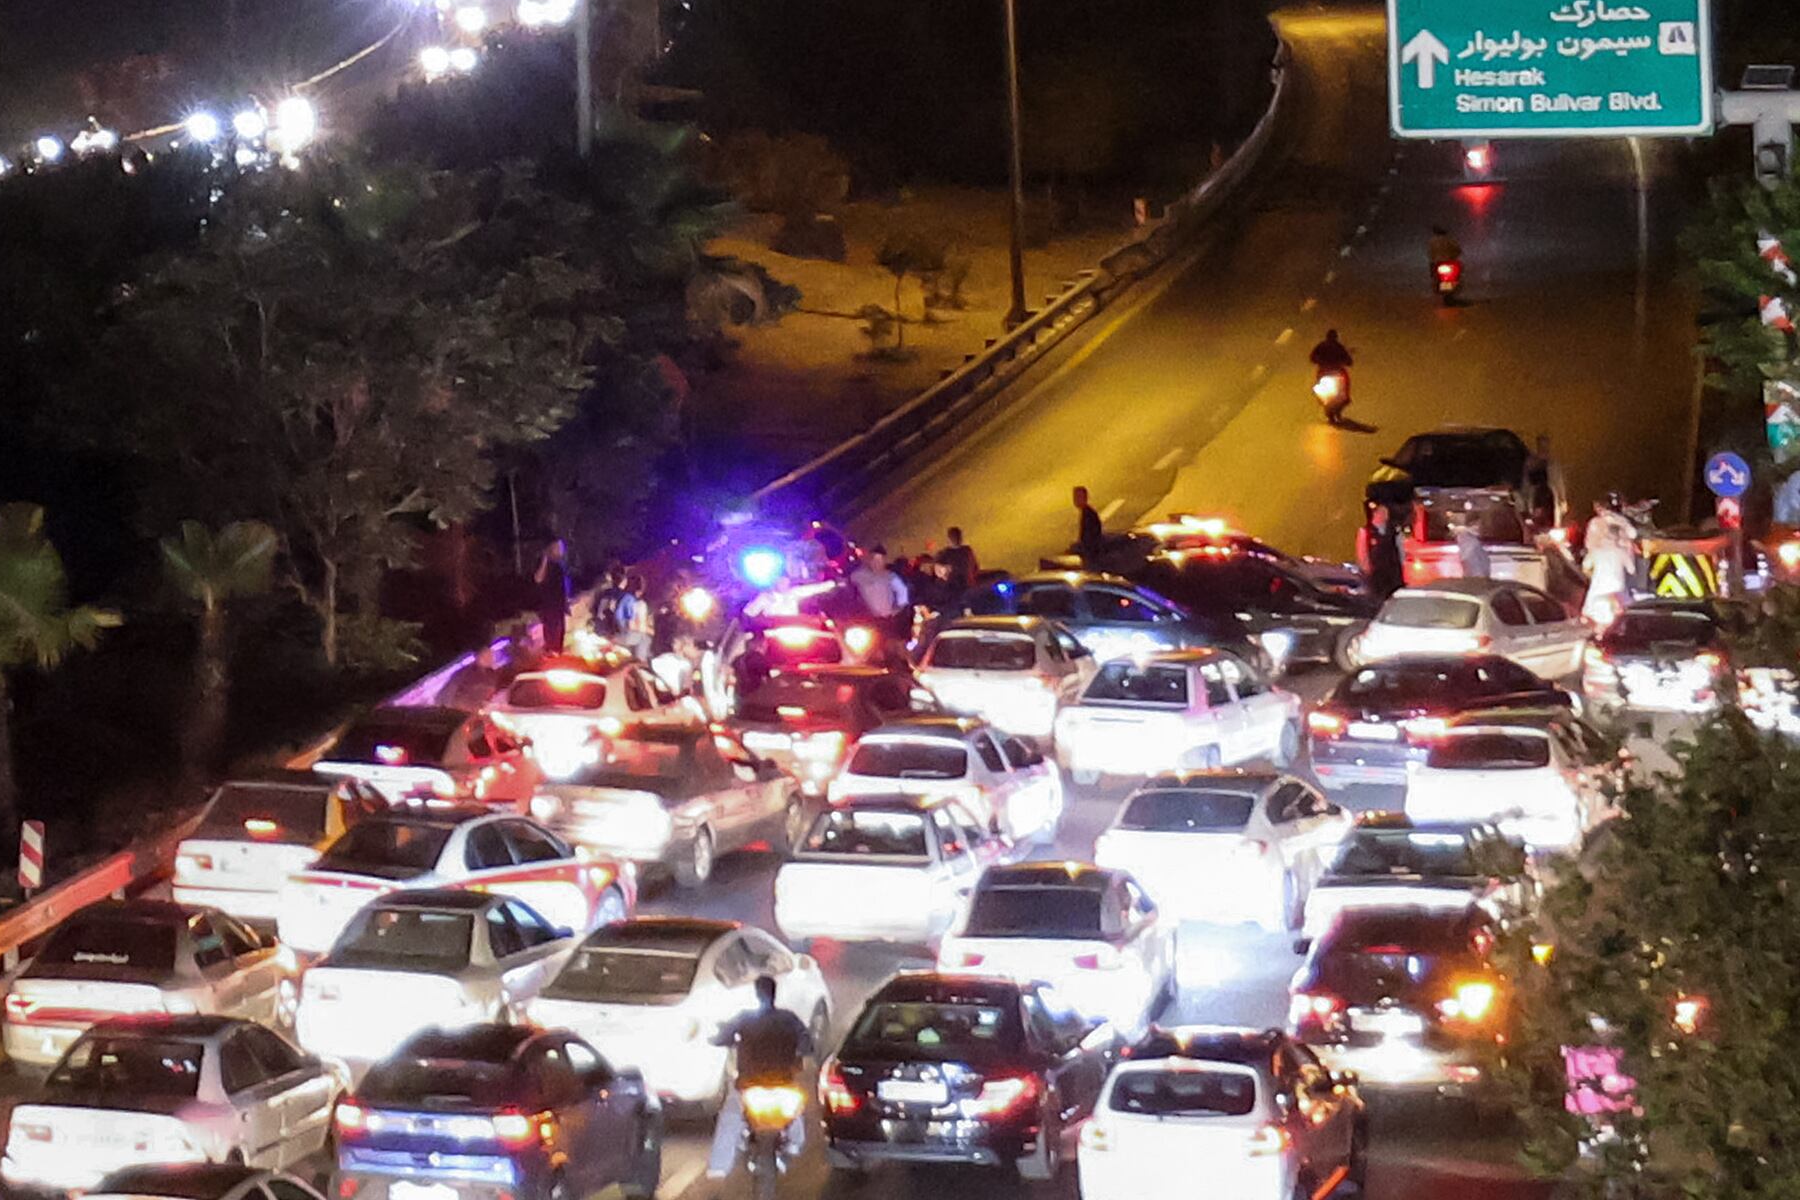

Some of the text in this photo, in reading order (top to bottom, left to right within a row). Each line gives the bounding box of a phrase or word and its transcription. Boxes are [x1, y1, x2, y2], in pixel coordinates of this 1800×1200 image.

[1457, 30, 1652, 61] سیمون بولیوار
[1454, 67, 1547, 86] Hesarak
[1456, 93, 1524, 112] Simon
[1608, 91, 1662, 111] Blvd.
